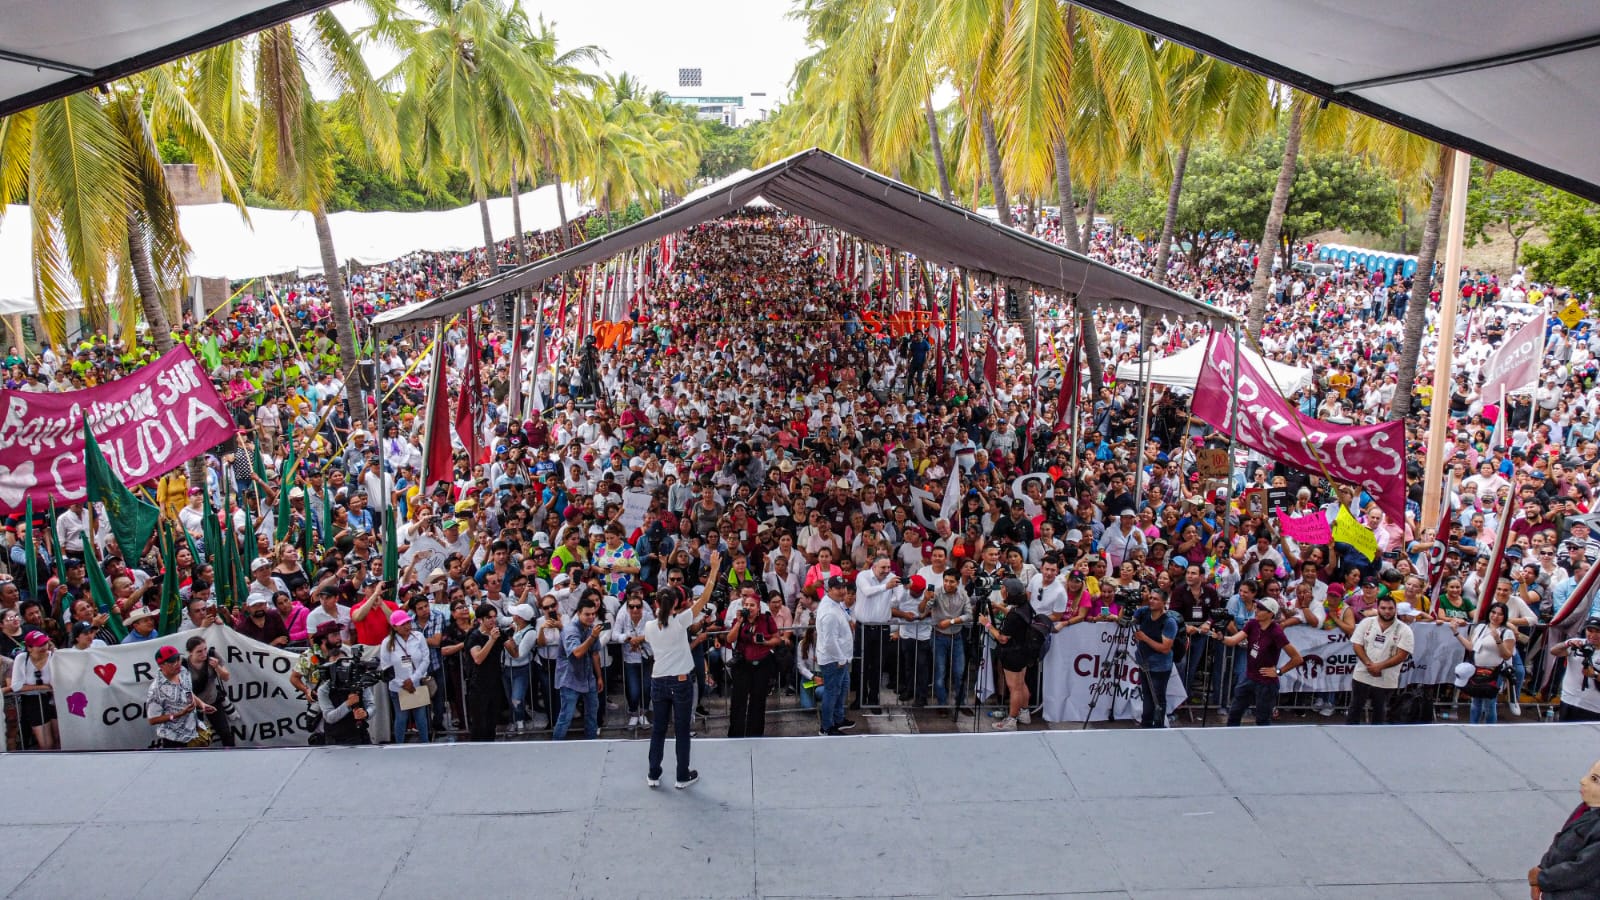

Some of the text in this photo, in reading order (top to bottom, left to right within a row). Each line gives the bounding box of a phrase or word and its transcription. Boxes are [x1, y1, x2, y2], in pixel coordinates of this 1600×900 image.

[0, 396, 66, 456] Baja
[50, 397, 229, 500] CAUDIA
[1326, 654, 1357, 666] QUE
